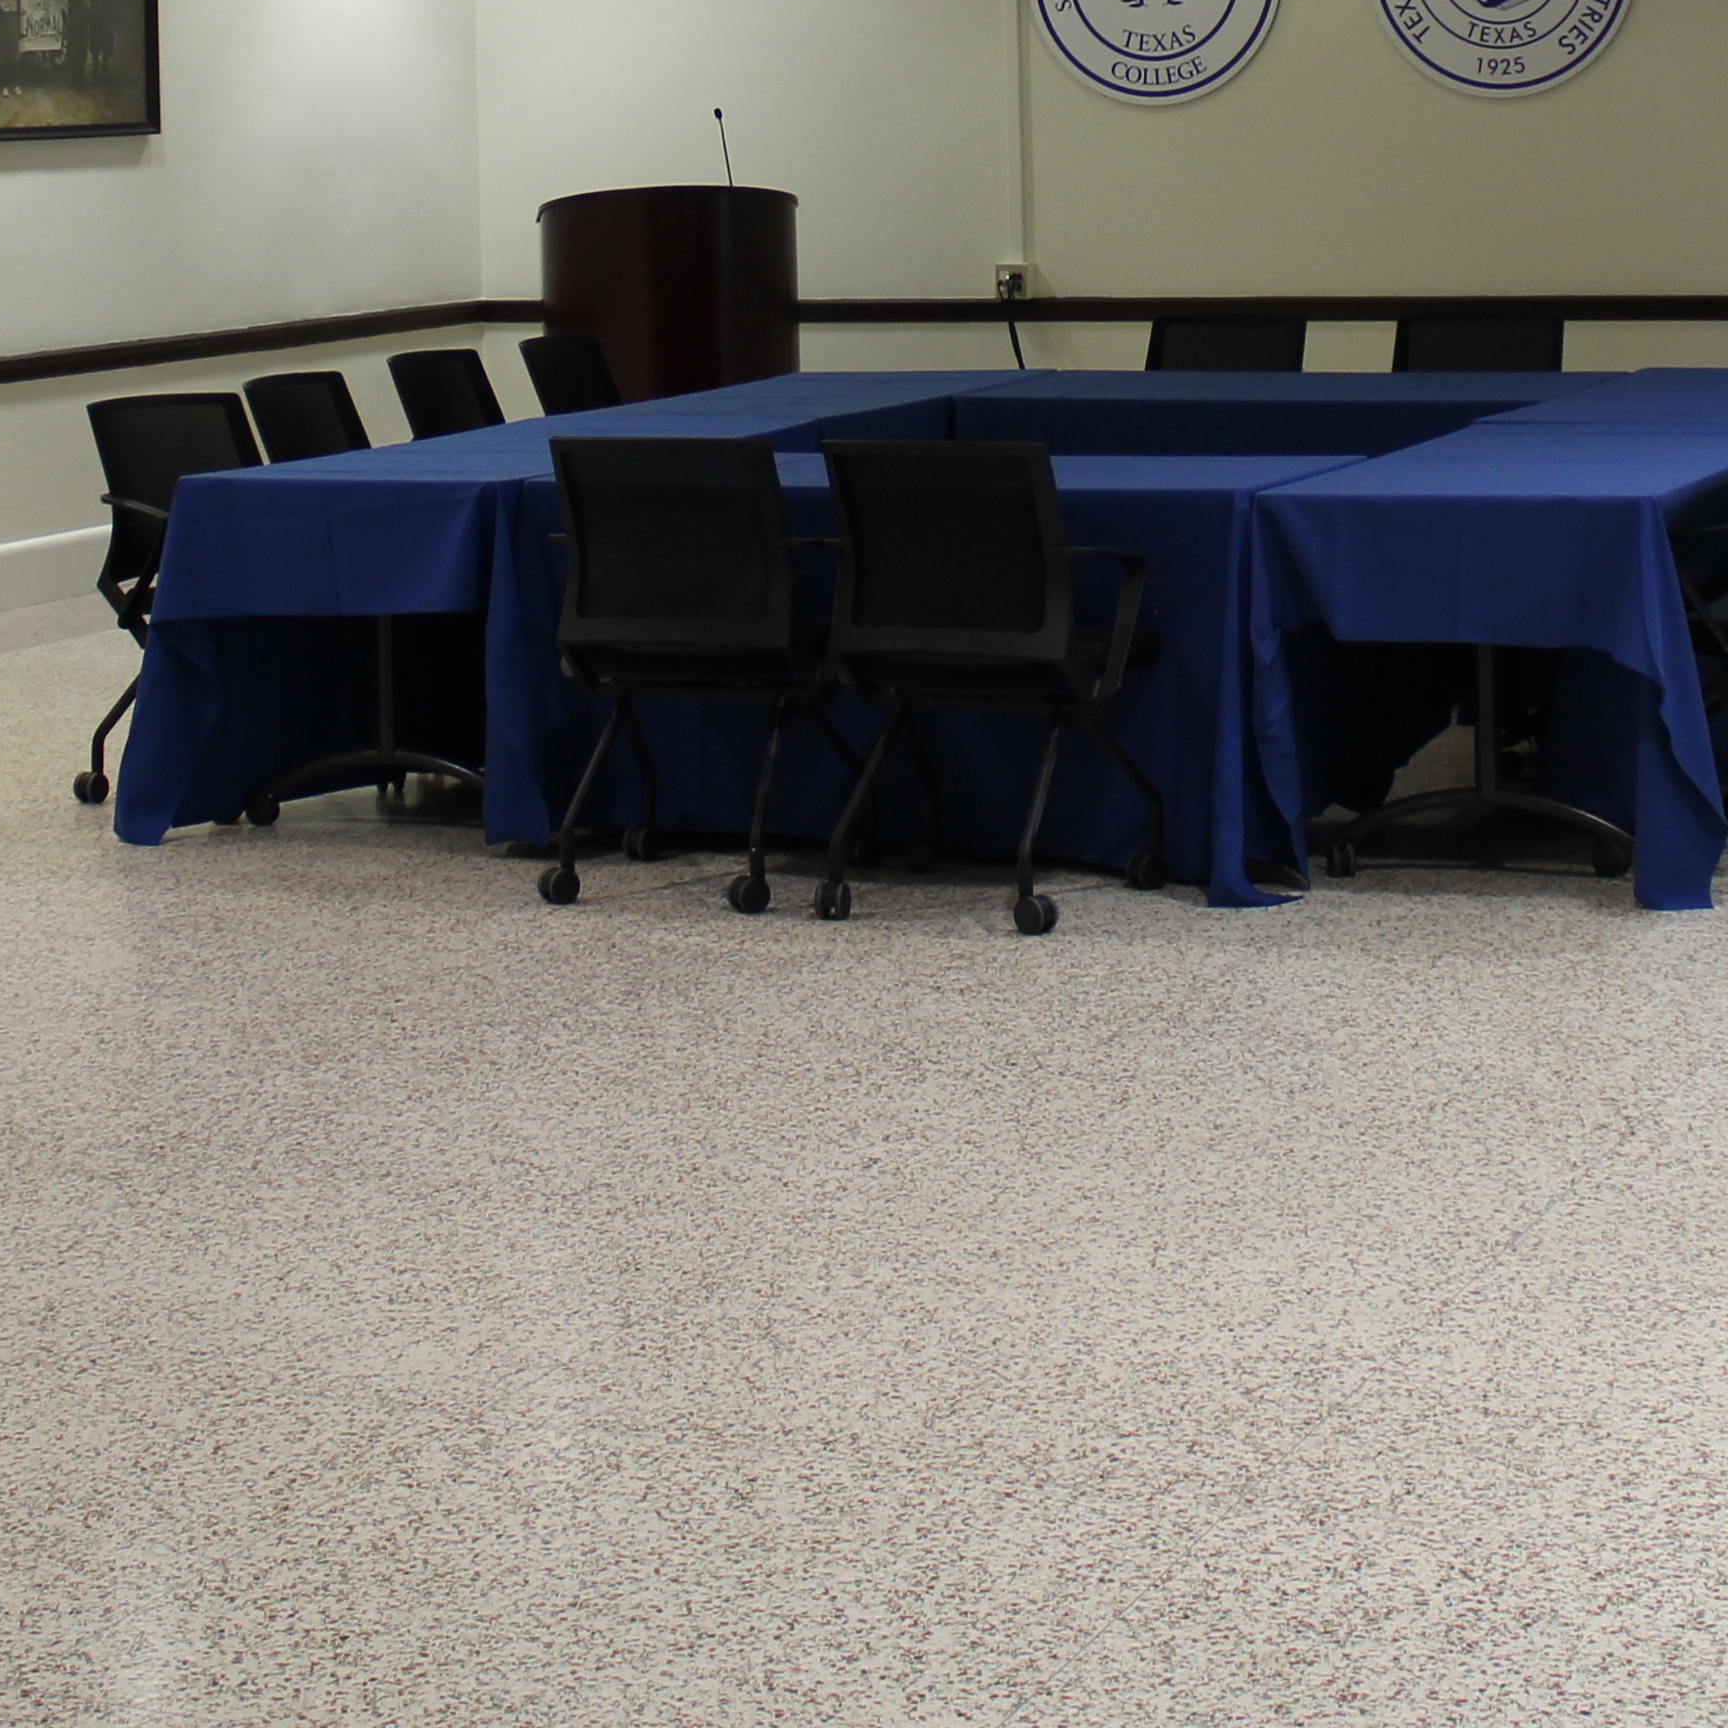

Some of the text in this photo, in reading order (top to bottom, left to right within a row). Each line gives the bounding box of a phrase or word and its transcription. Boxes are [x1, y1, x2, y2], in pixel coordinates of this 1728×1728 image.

[1122, 24, 1196, 52] TEXAS
[1468, 21, 1537, 44] TEXAS
[1111, 55, 1208, 86] COLLEGE
[1477, 56, 1525, 76] 1925
